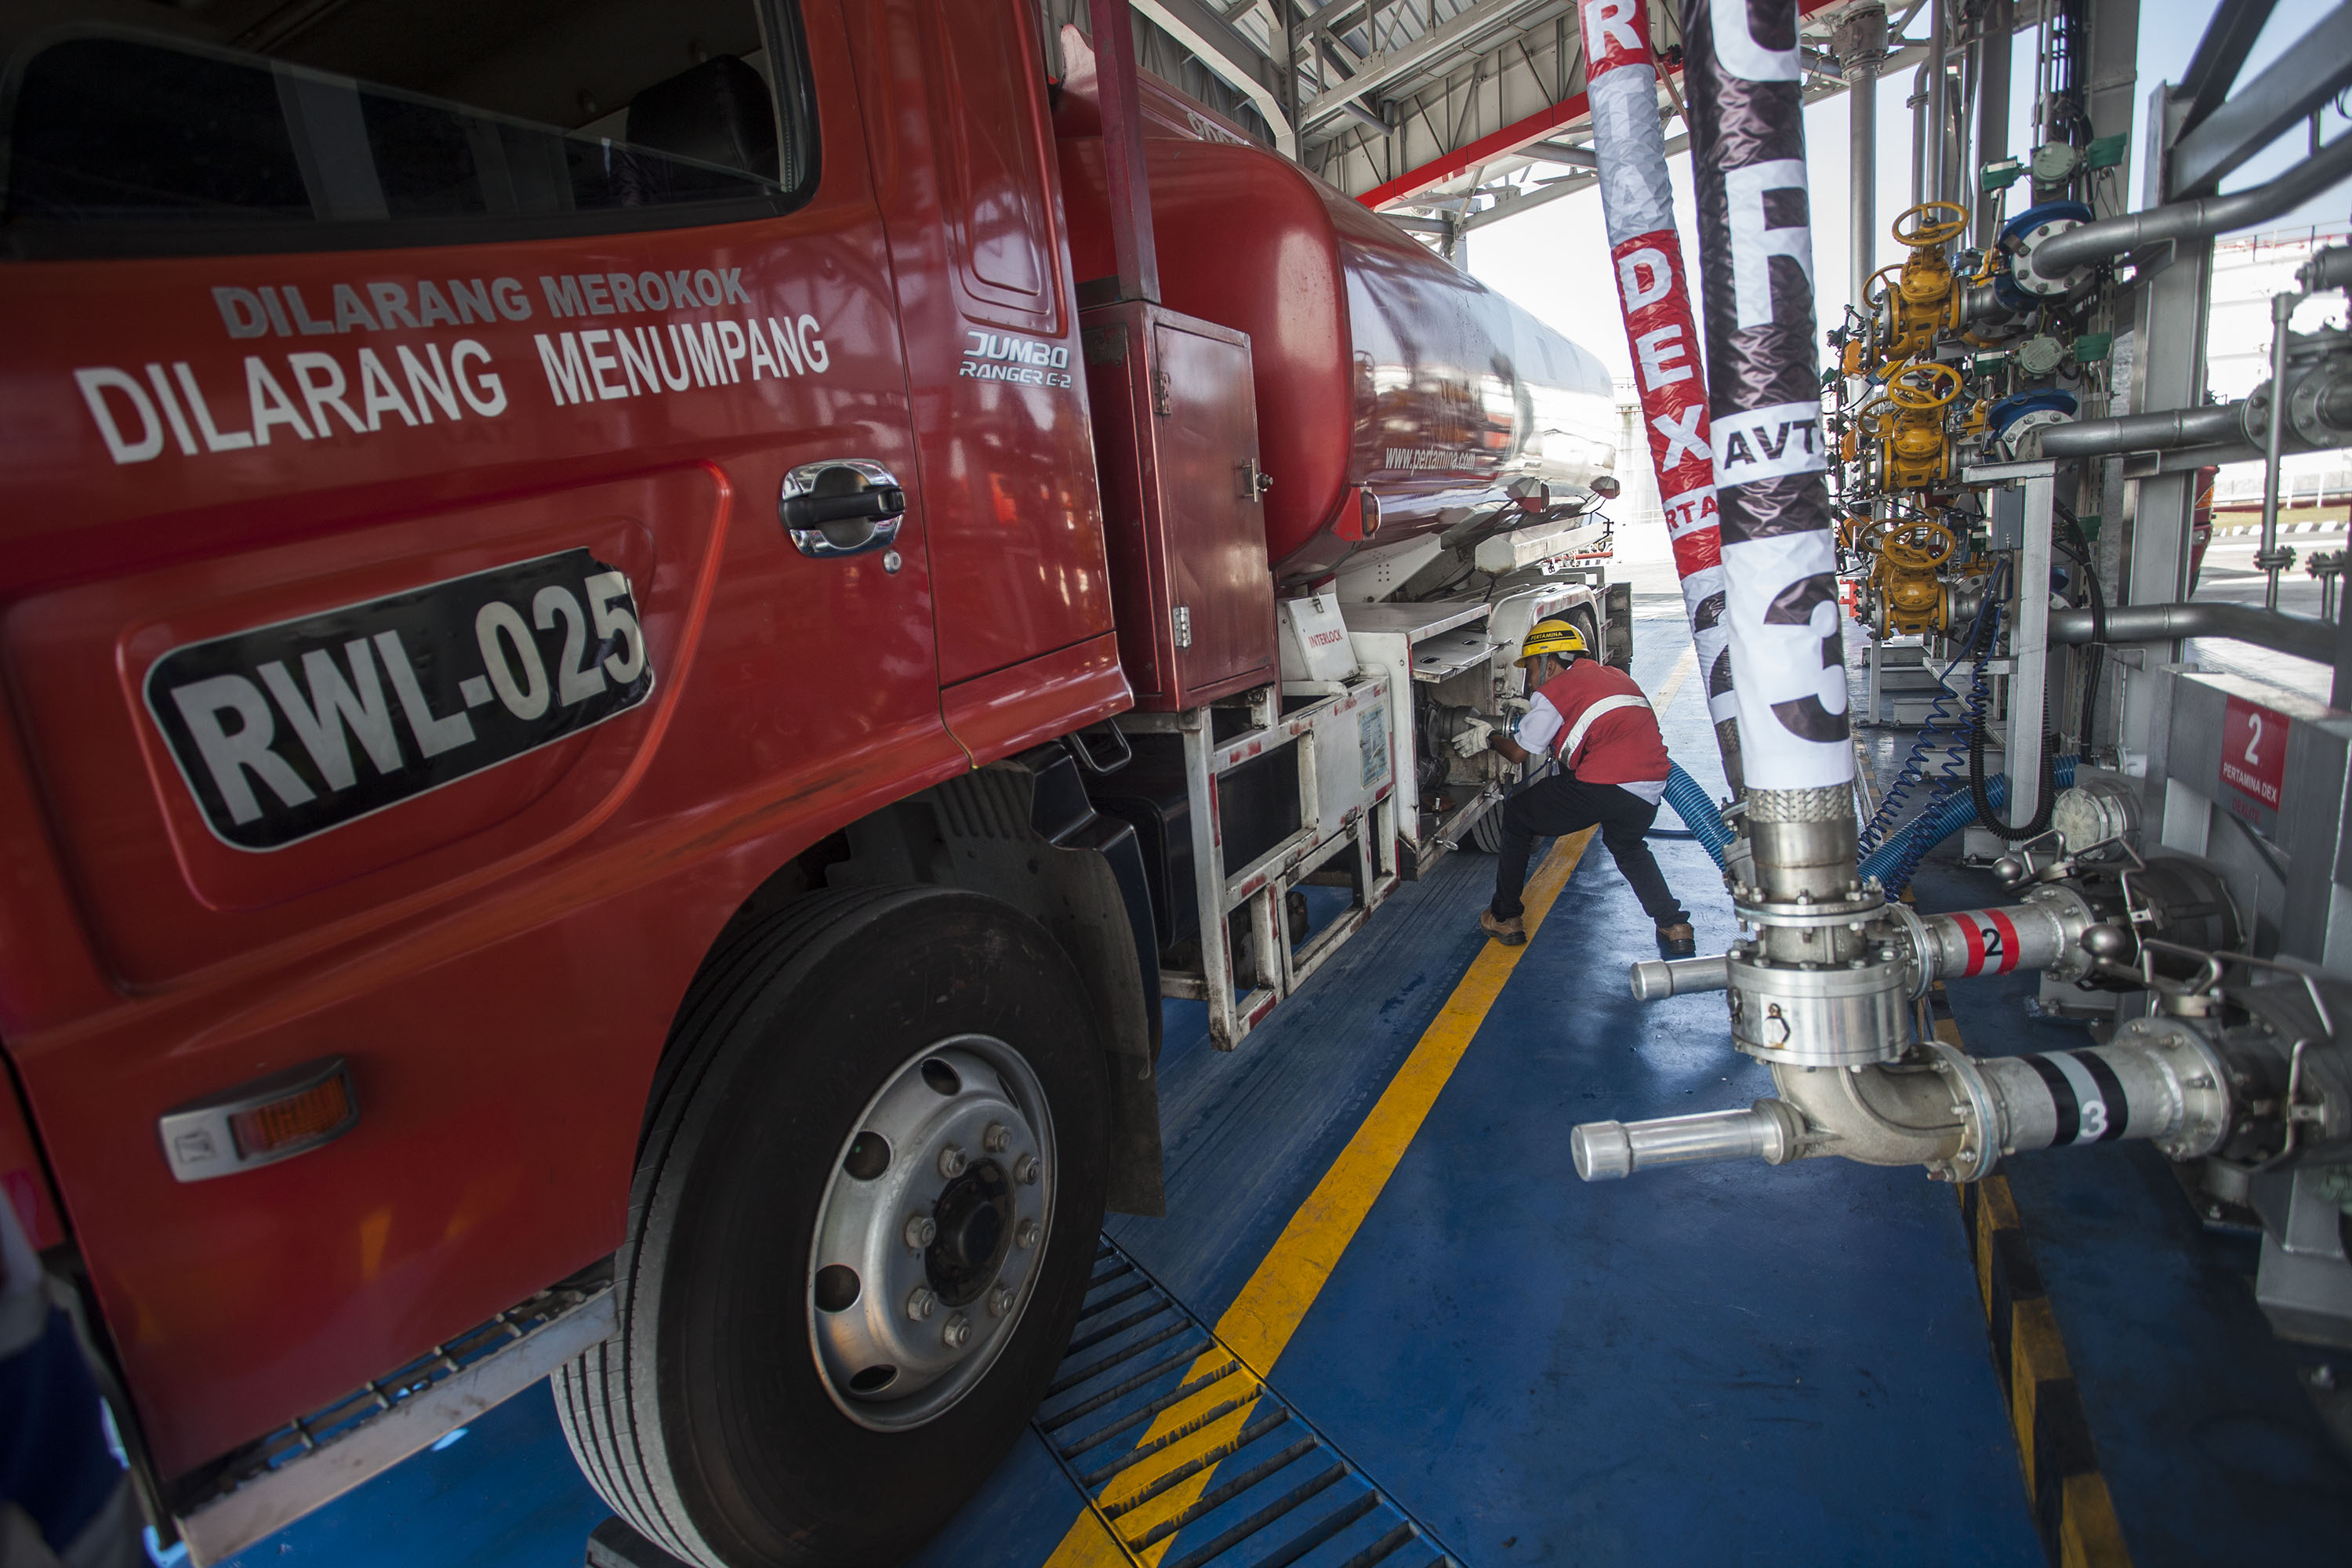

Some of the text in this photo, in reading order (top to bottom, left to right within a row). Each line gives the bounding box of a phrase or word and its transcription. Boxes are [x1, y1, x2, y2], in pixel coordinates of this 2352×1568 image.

[212, 267, 752, 339] DILARANG MEROKOK
[964, 331, 1069, 369] JUMBO
[74, 312, 831, 465] DILARANG MENUMPANG
[959, 361, 1043, 385] RANGER
[1385, 445, 1475, 477] www.pertamina.com
[1724, 418, 1827, 471] AVT
[1308, 628, 1343, 648] INTERLOCK
[1530, 631, 1563, 641] PERTAMINA
[1763, 572, 1851, 742] 3
[169, 569, 648, 828] RWL-025
[2245, 713, 2262, 766] 2
[2223, 762, 2278, 804] PERTAMINA DEX
[1982, 928, 2004, 957] 2
[2080, 1100, 2109, 1138] 3
